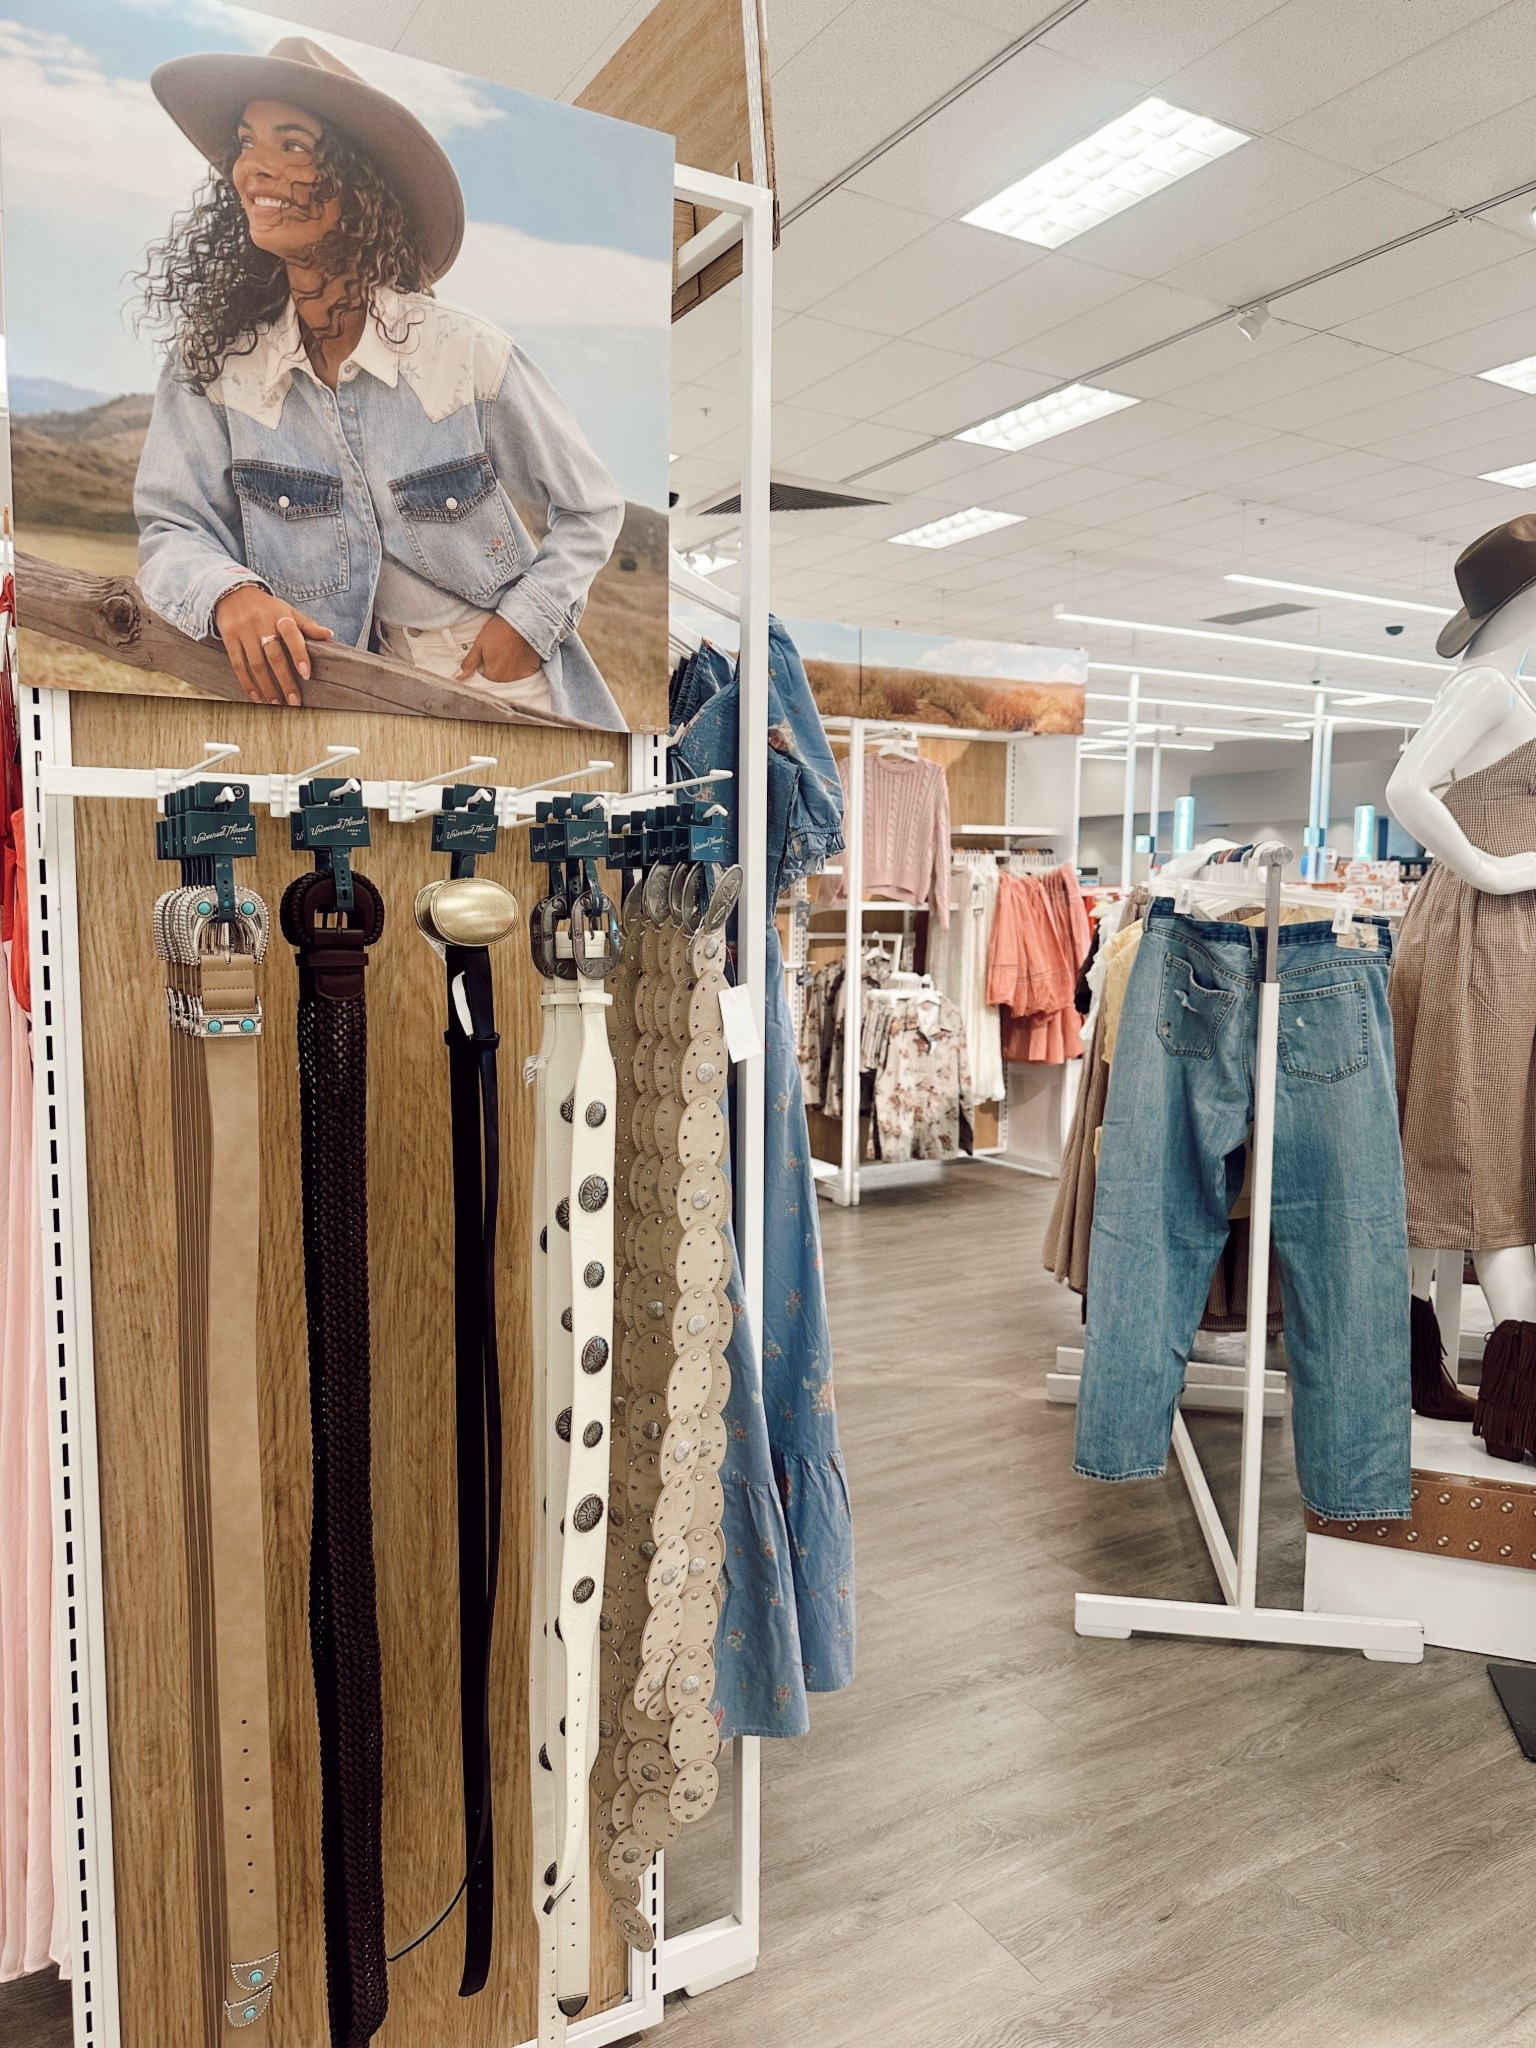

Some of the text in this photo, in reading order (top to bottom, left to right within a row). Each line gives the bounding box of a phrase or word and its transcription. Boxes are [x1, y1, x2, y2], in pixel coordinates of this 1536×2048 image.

[192, 828, 227, 845] Universal
[221, 823, 251, 838] Thread
[310, 821, 342, 836] Universal
[337, 816, 365, 830] Thread
[446, 827, 474, 840] Universal
